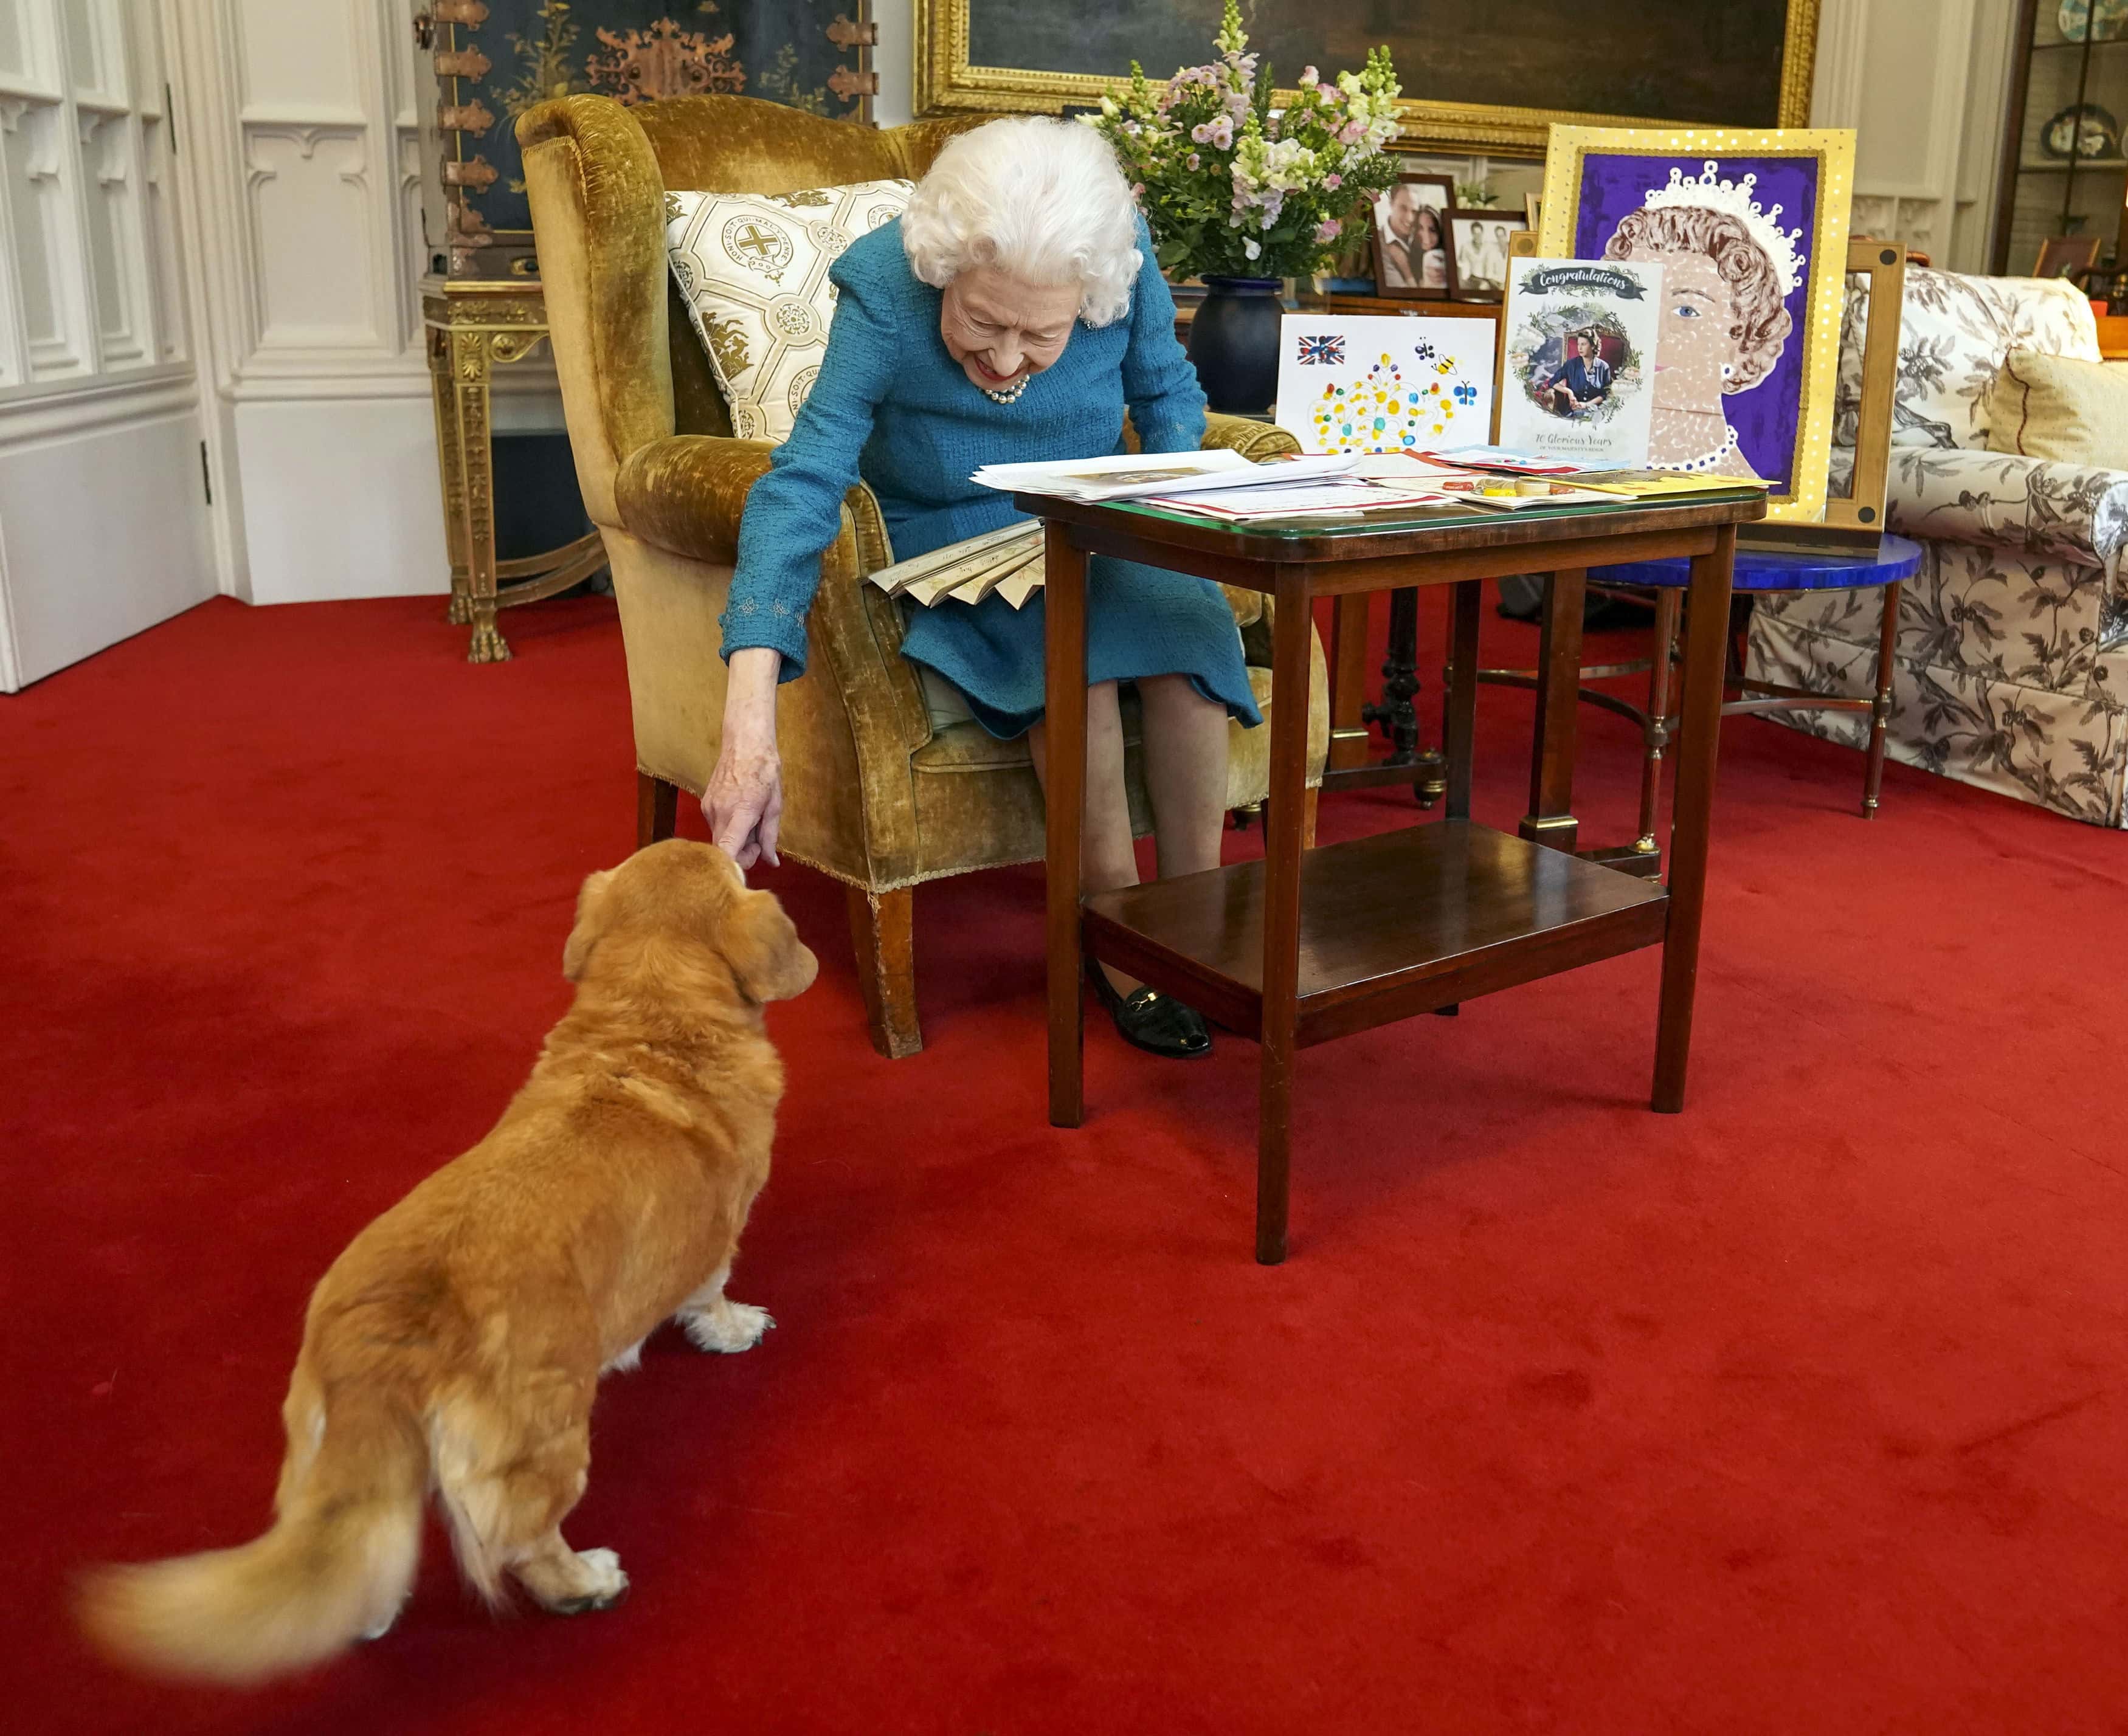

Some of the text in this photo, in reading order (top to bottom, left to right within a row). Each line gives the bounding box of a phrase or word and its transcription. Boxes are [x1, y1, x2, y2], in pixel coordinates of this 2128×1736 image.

[725, 221, 736, 239] SOIT
[727, 243, 742, 261] HONI
[1539, 268, 1626, 289] Congratulations
[792, 376, 804, 397] SOIT
[1547, 433, 1585, 445] Glorious
[1588, 435, 1612, 446] Years
